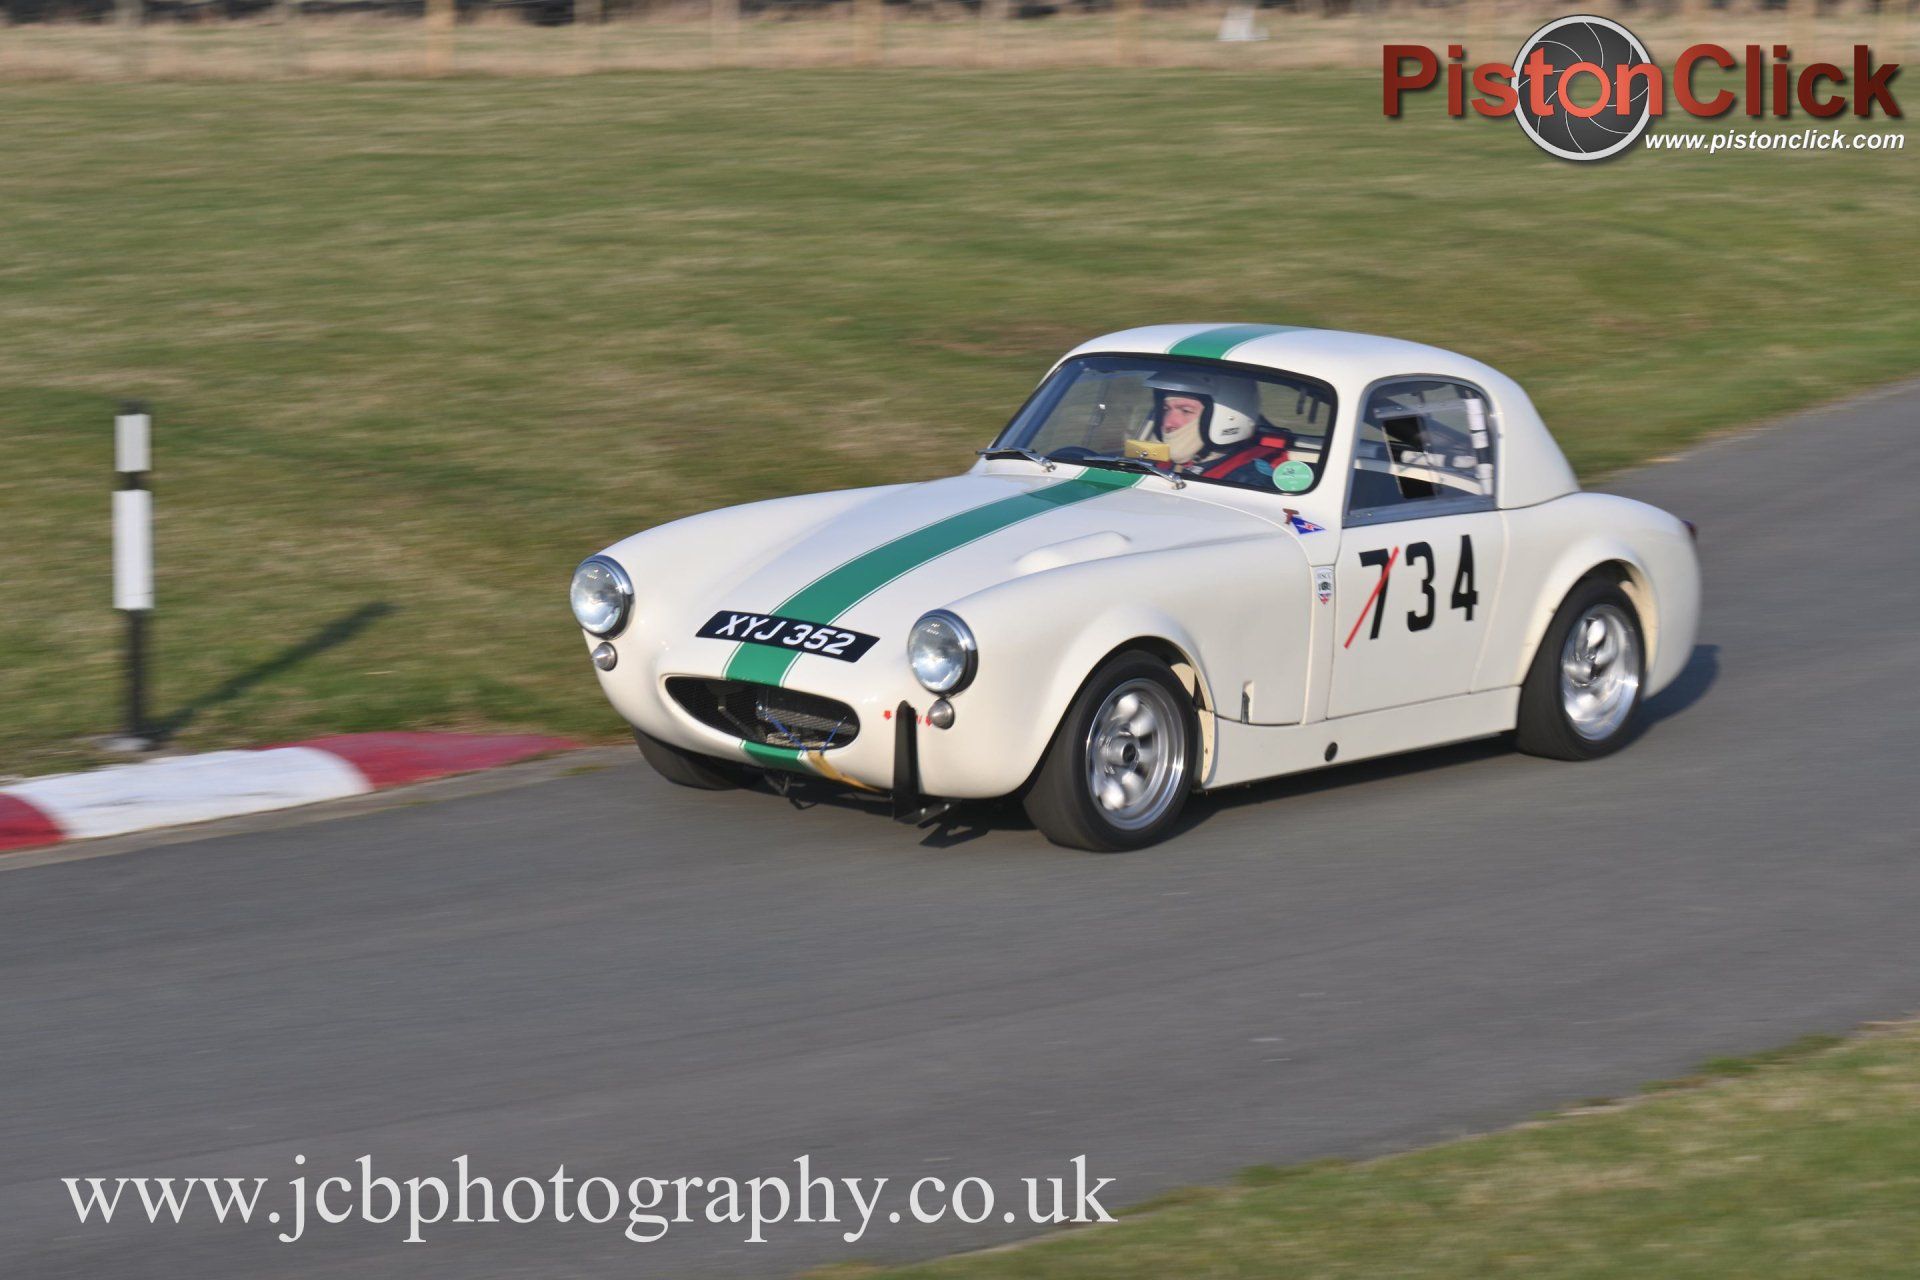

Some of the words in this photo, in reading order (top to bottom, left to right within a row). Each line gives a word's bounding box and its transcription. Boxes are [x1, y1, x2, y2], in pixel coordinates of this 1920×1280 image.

[1359, 534, 1478, 640] 734
[715, 614, 787, 641] XYJ
[782, 624, 856, 655] 352
